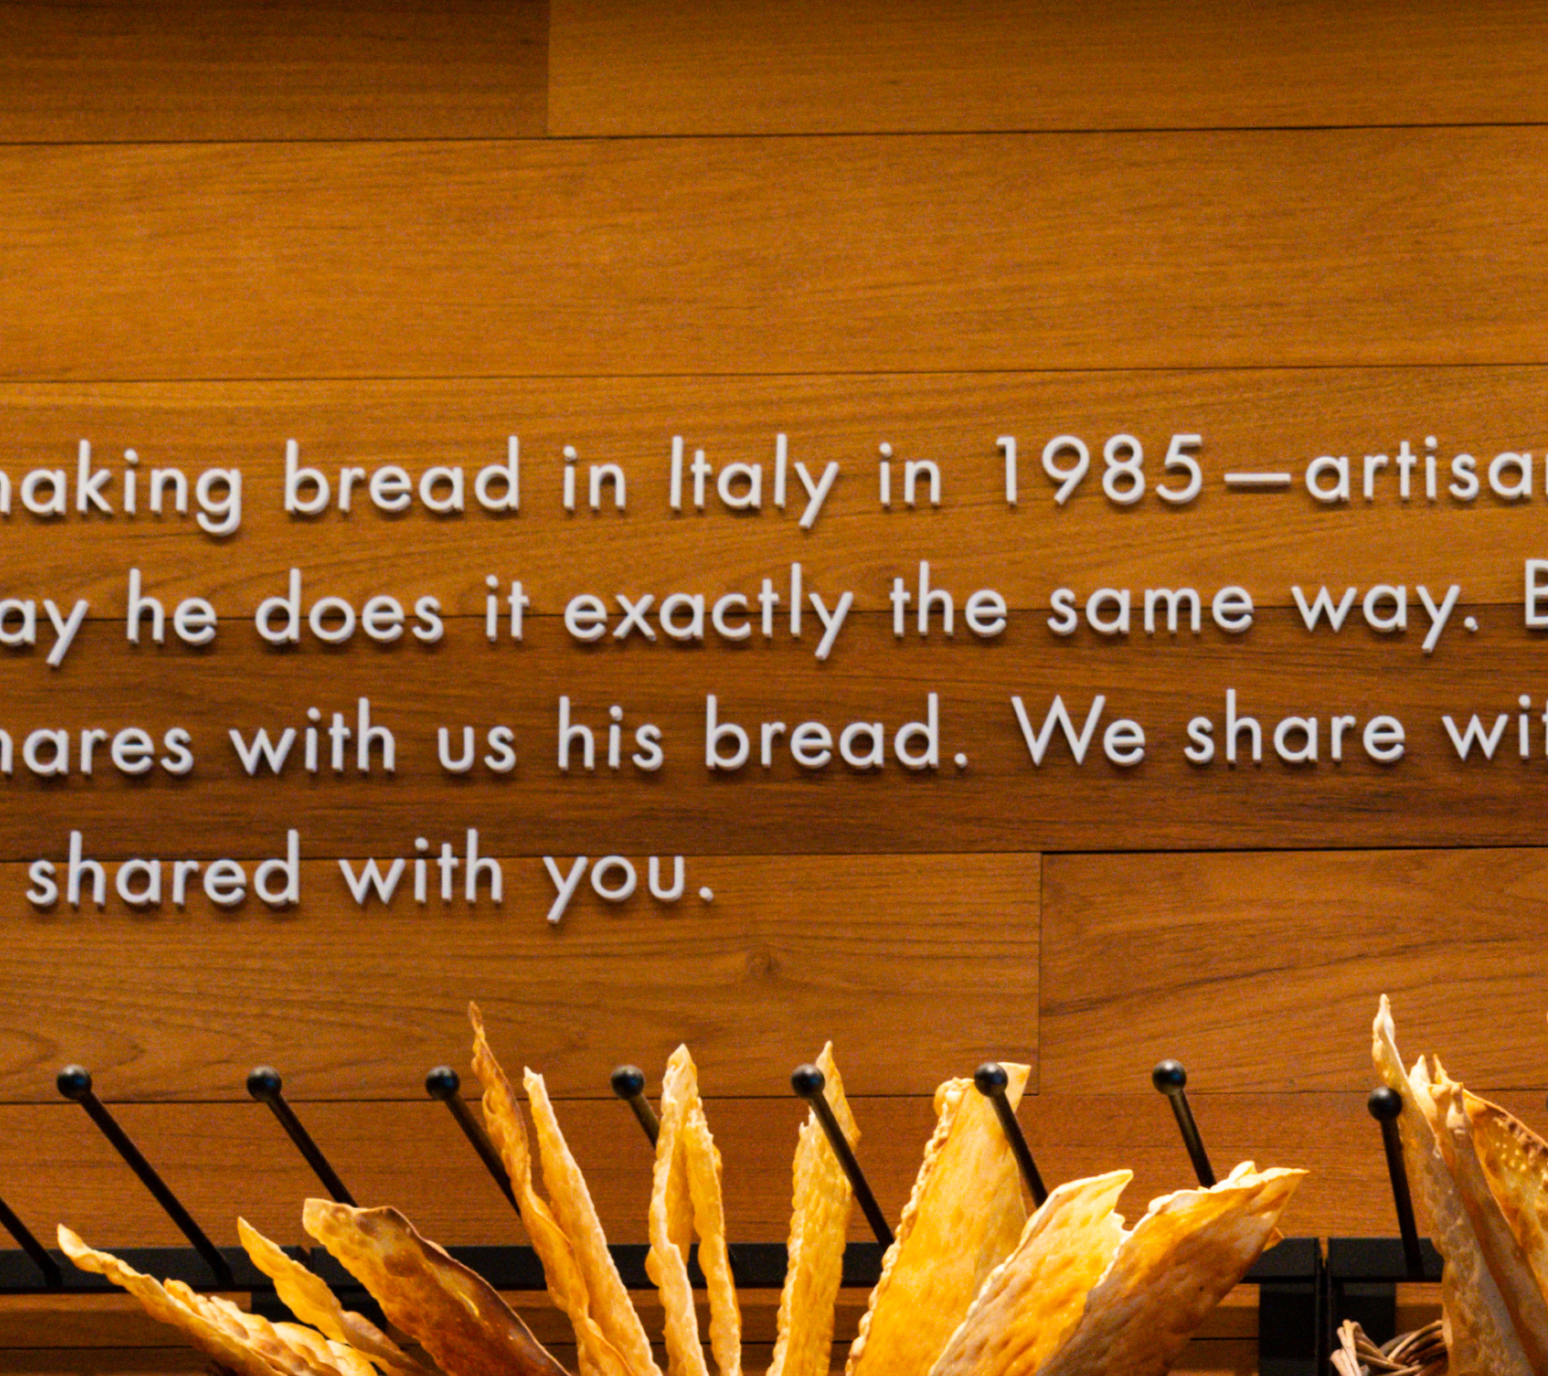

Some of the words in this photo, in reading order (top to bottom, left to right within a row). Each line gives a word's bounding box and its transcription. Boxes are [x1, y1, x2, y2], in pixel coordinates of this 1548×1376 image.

[282, 432, 522, 514] bread
[561, 442, 628, 511] in
[667, 430, 842, 530] Italy
[877, 439, 943, 506] in
[124, 565, 219, 644] he
[253, 565, 446, 644] does
[483, 572, 532, 641] it
[562, 559, 856, 662] exactly
[887, 557, 1009, 637] the
[1045, 583, 1256, 635] same
[1288, 581, 1481, 653] way.
[226, 694, 397, 776] with
[435, 723, 518, 773] us
[556, 693, 666, 771] his
[703, 689, 970, 770] bread.
[1008, 692, 1148, 767] We
[1181, 685, 1408, 764] share
[23, 826, 302, 907] shared
[336, 825, 505, 906] with
[540, 853, 715, 924] you.
